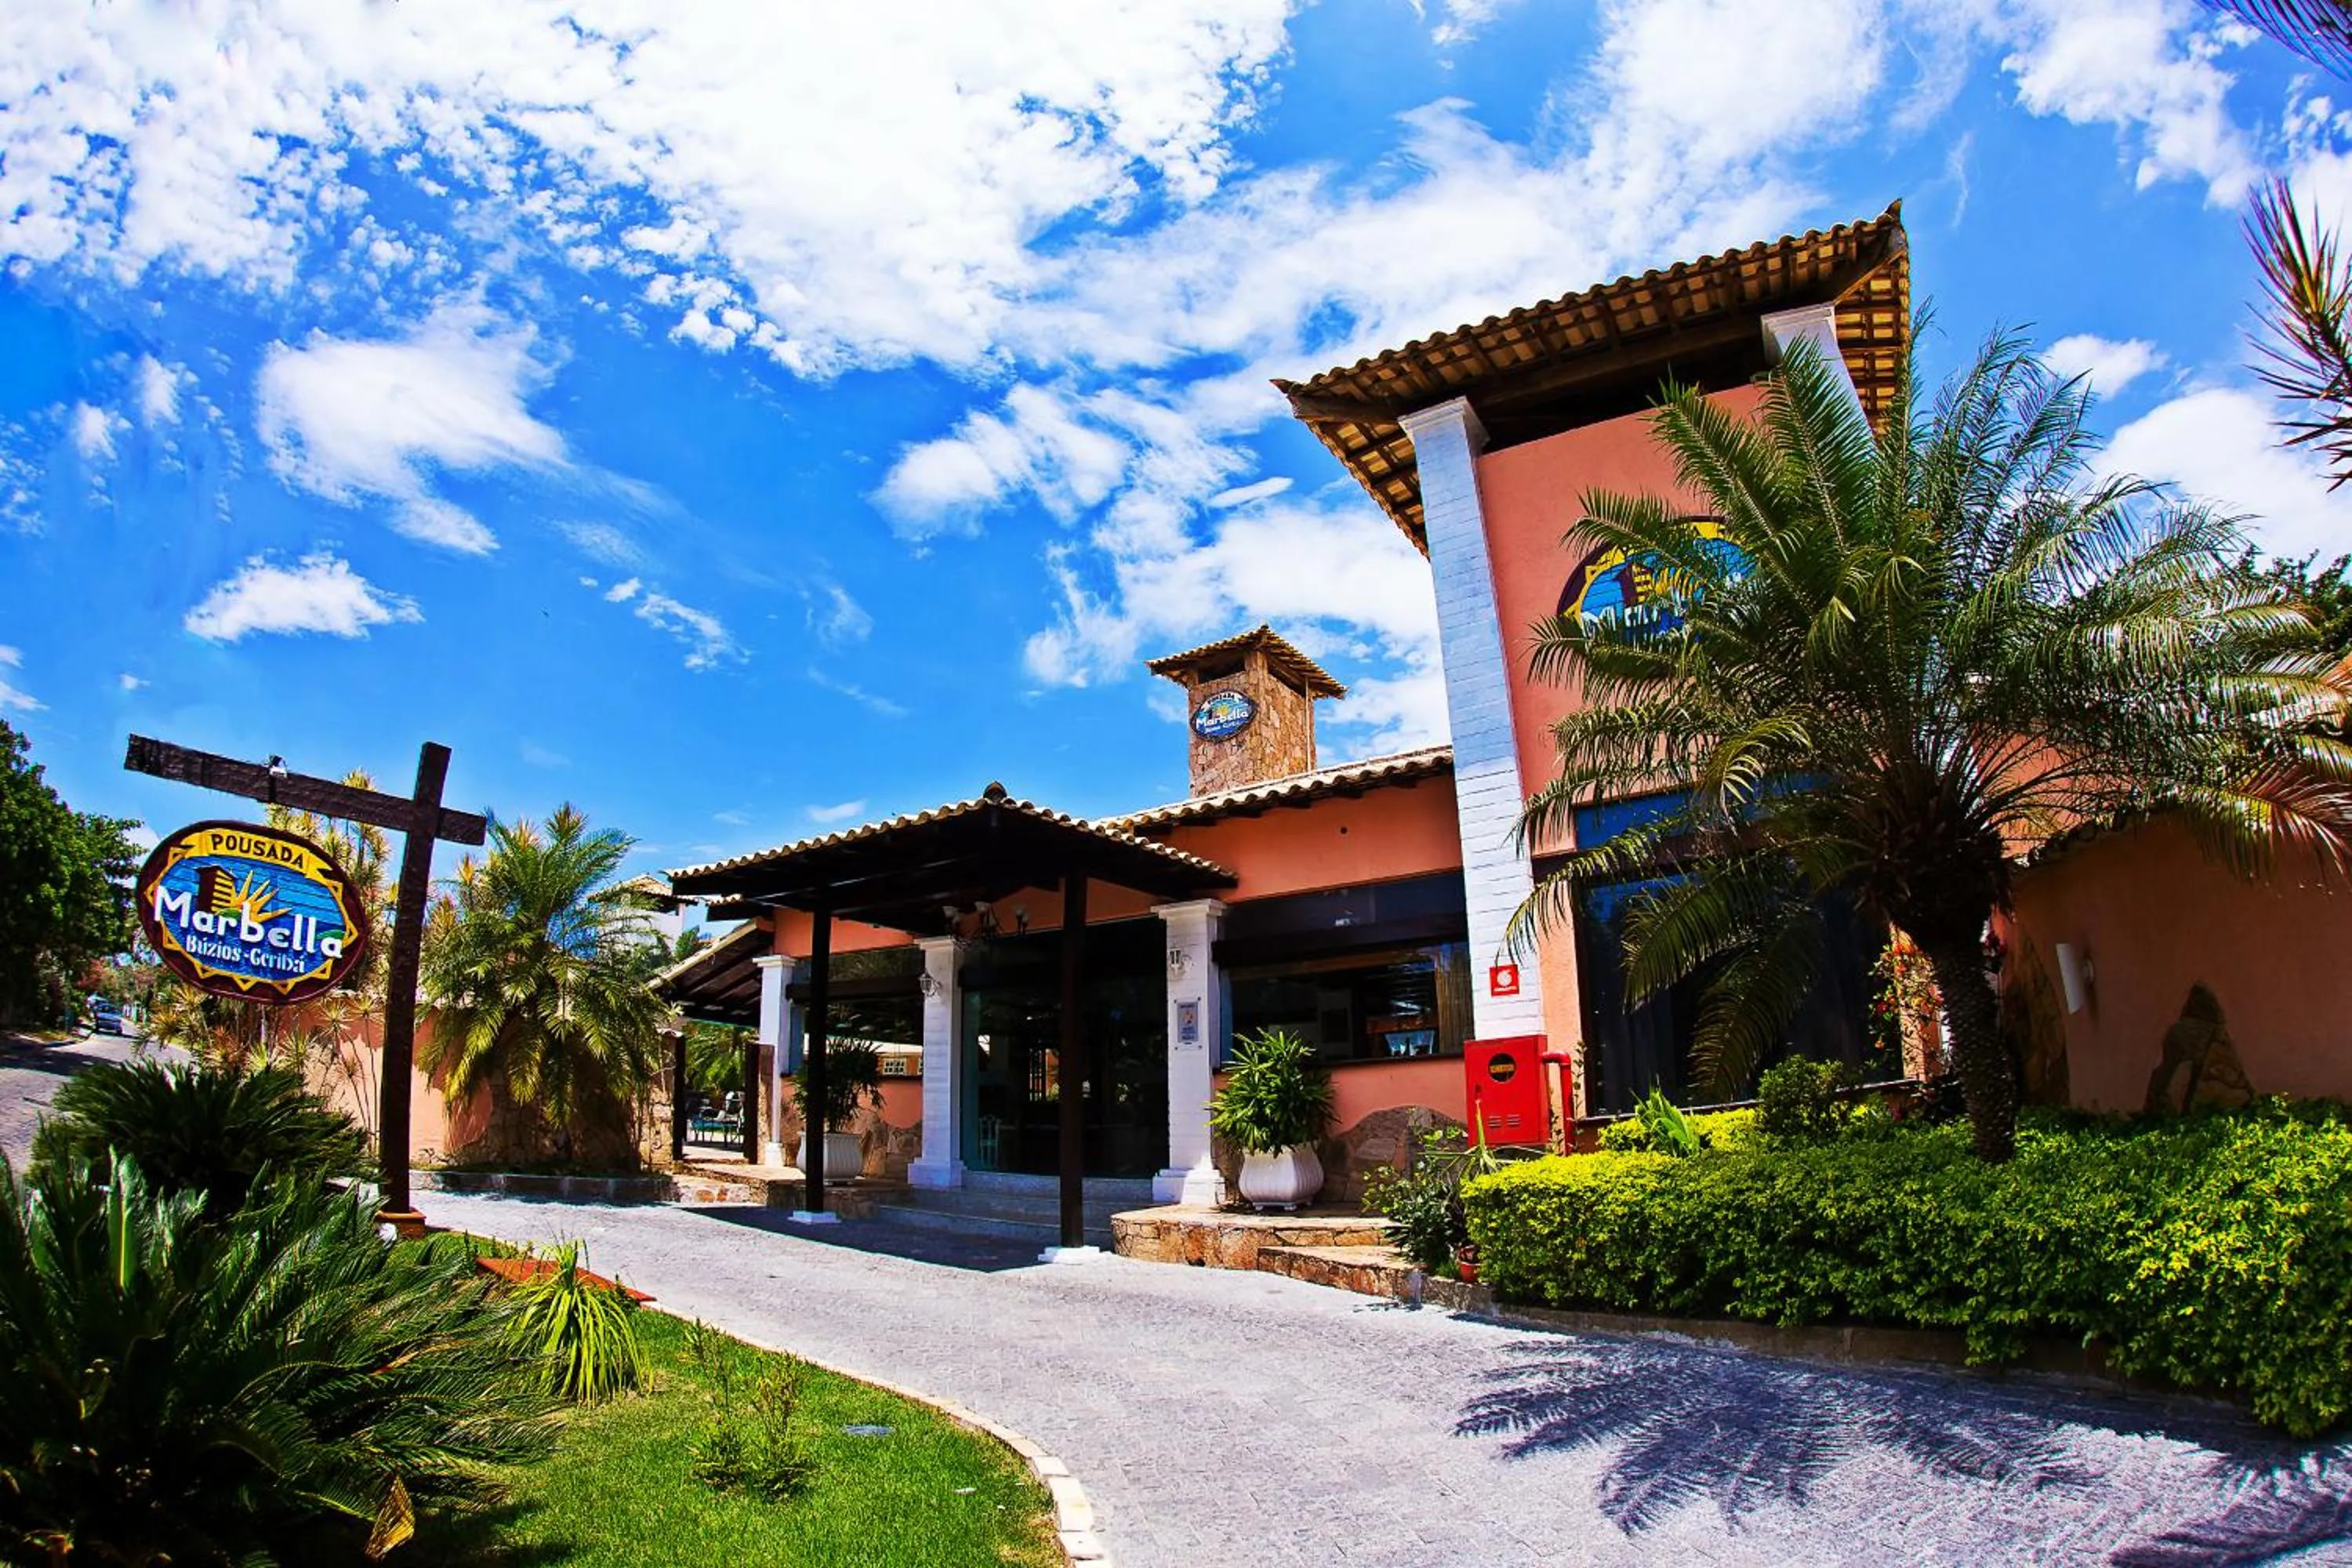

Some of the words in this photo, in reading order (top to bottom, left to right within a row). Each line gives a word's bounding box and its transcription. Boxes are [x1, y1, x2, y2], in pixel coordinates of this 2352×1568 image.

[1196, 708, 1249, 729] Marbella
[210, 833, 305, 869] POUSADA
[154, 886, 343, 959] Marbella
